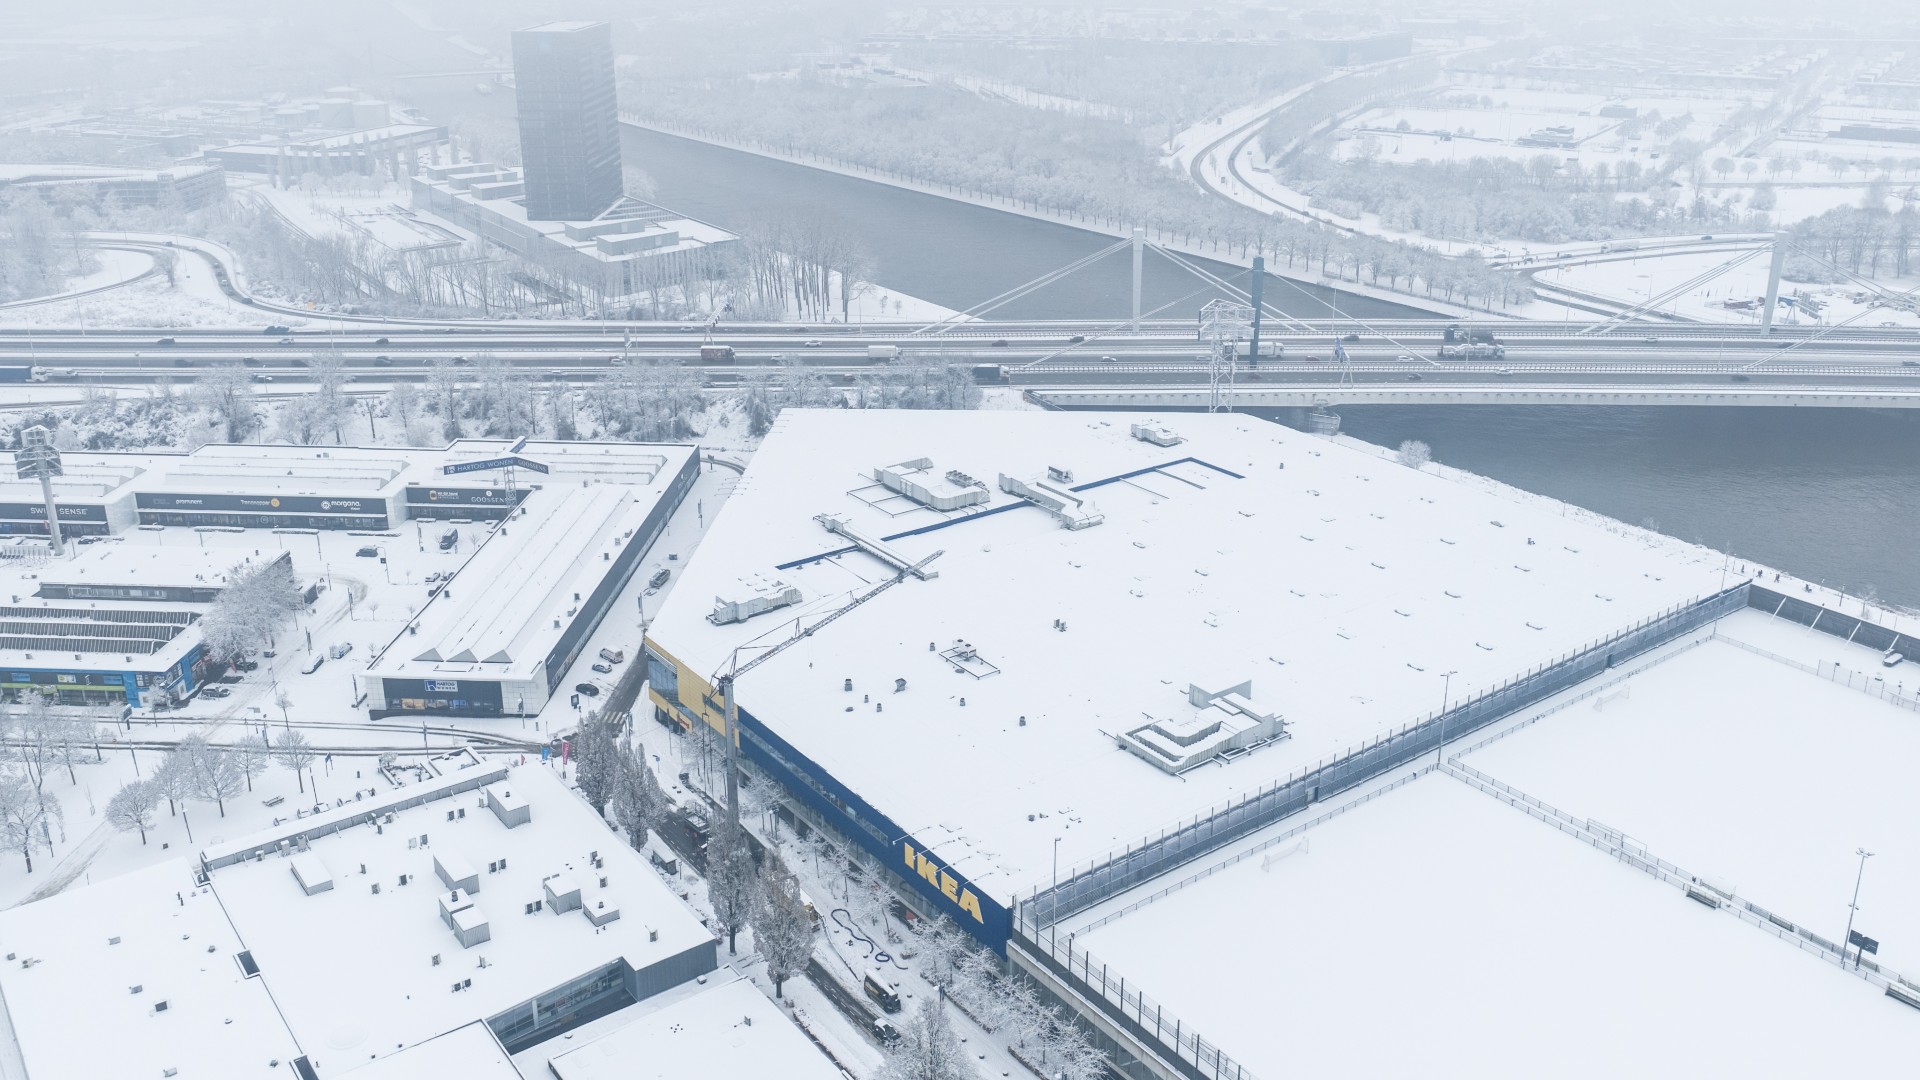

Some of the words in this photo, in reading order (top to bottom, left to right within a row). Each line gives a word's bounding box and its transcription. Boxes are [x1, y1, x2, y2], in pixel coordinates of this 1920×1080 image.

[457, 462, 485, 472] HARTOG
[487, 459, 514, 468] WONEN
[517, 460, 547, 473] GOOSSENS
[904, 842, 984, 924] IKEA
